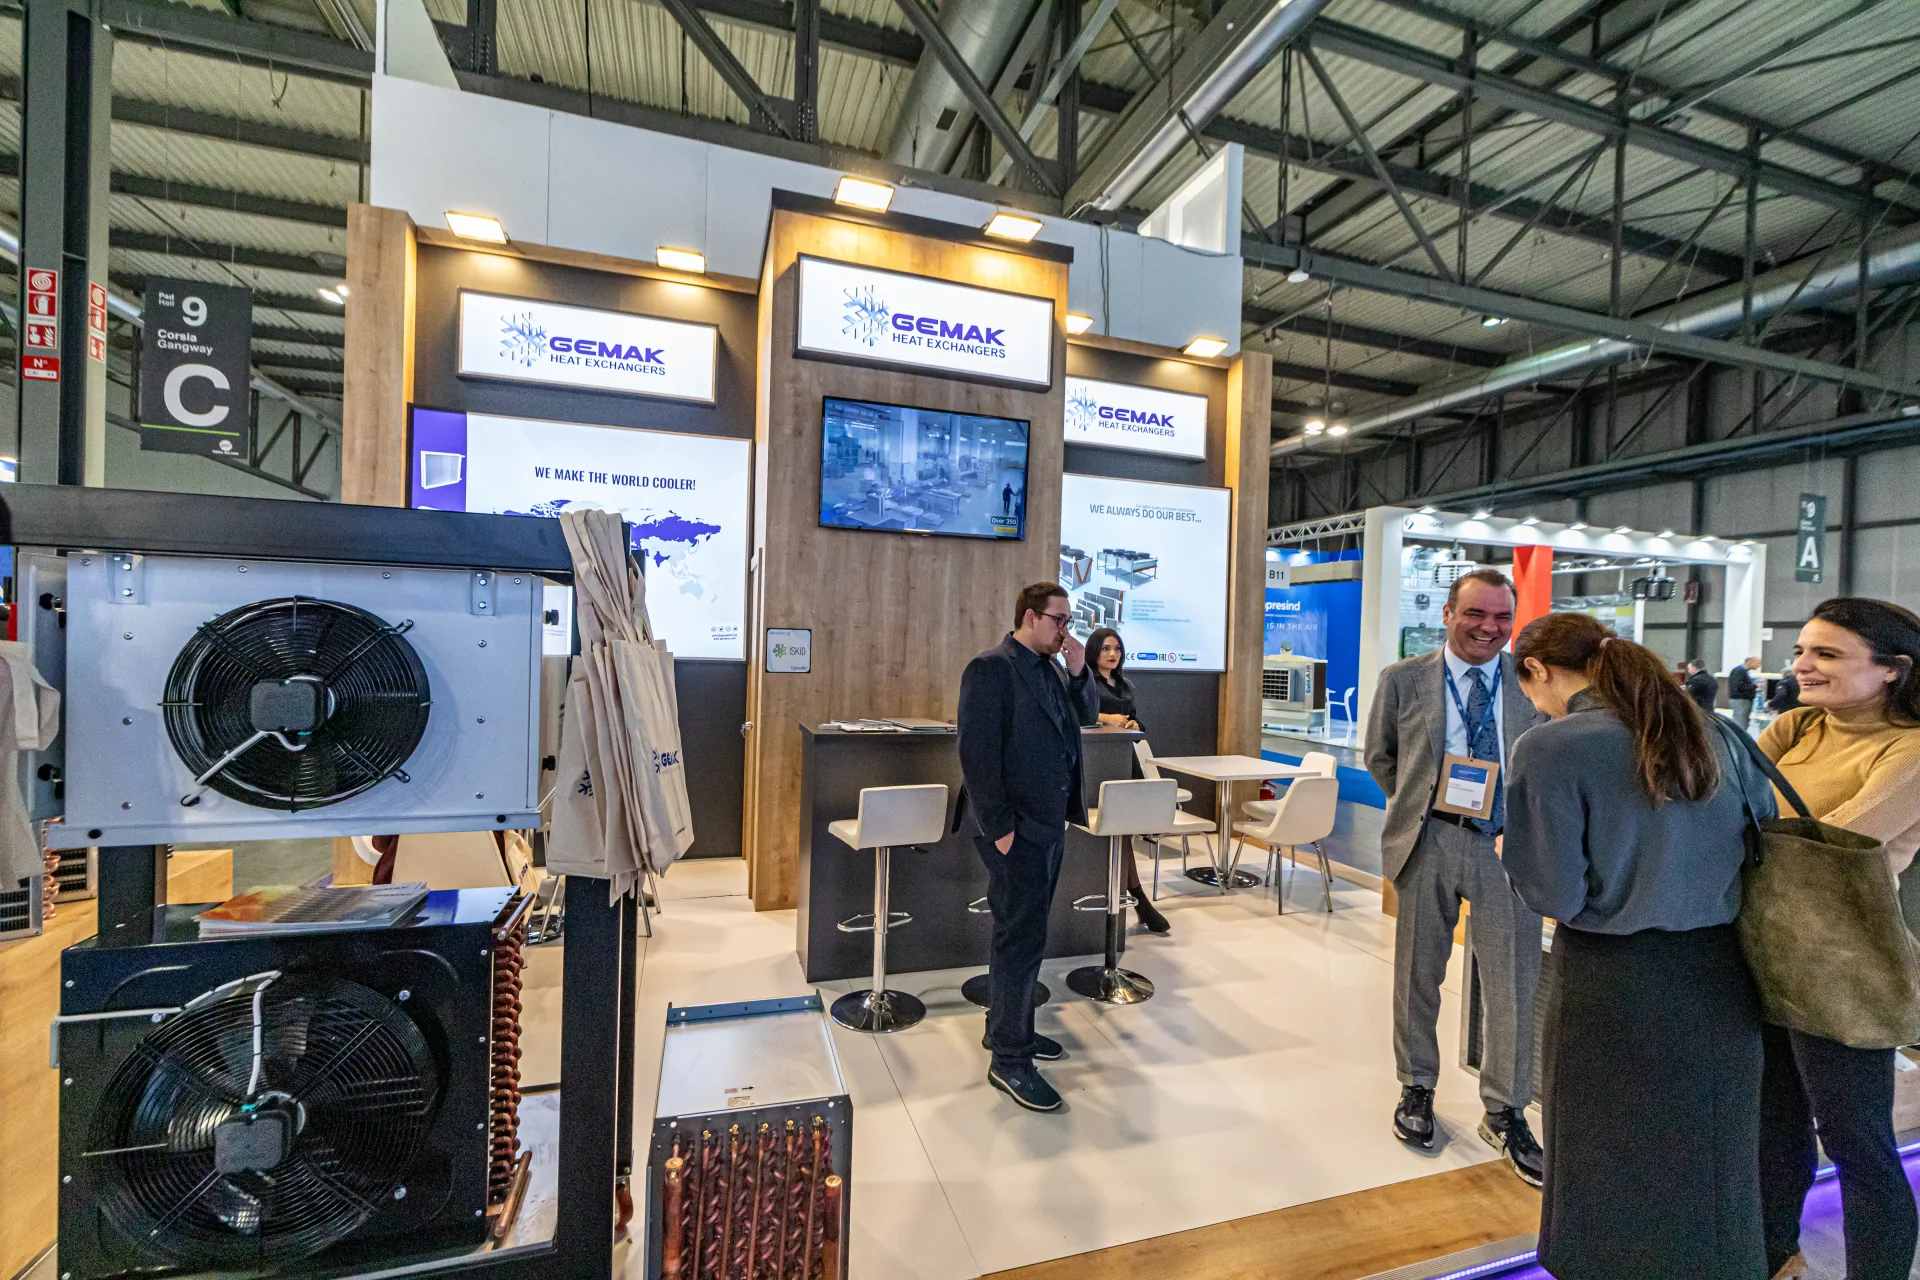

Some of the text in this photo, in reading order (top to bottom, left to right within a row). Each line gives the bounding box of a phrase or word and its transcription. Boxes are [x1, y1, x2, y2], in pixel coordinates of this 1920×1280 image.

[158, 291, 175, 300] Pad
[158, 299, 175, 307] Hall
[182, 296, 207, 326] 9
[157, 329, 197, 343] Corsia
[891, 313, 1006, 346] GEMAK
[157, 339, 213, 356] Gangway
[549, 336, 665, 365] GEMAK
[892, 333, 1006, 358] HEAT EXCHANGERS
[550, 354, 666, 376] HEAT EXCHANGERS
[163, 363, 230, 427] C
[1098, 405, 1175, 428] GEMAK
[1099, 421, 1175, 437] HEAT EXCHANGERS
[535, 466, 696, 490] WE MAKE THE WORLD COOLER!
[1090, 504, 1202, 523] WE ALWAYS DO OUR BEST...
[1806, 502, 1816, 518] 9
[1799, 536, 1819, 568] A
[1269, 569, 1285, 580] B11
[1265, 600, 1301, 611] presind
[1266, 622, 1274, 630] IS
[1276, 622, 1285, 630] IN
